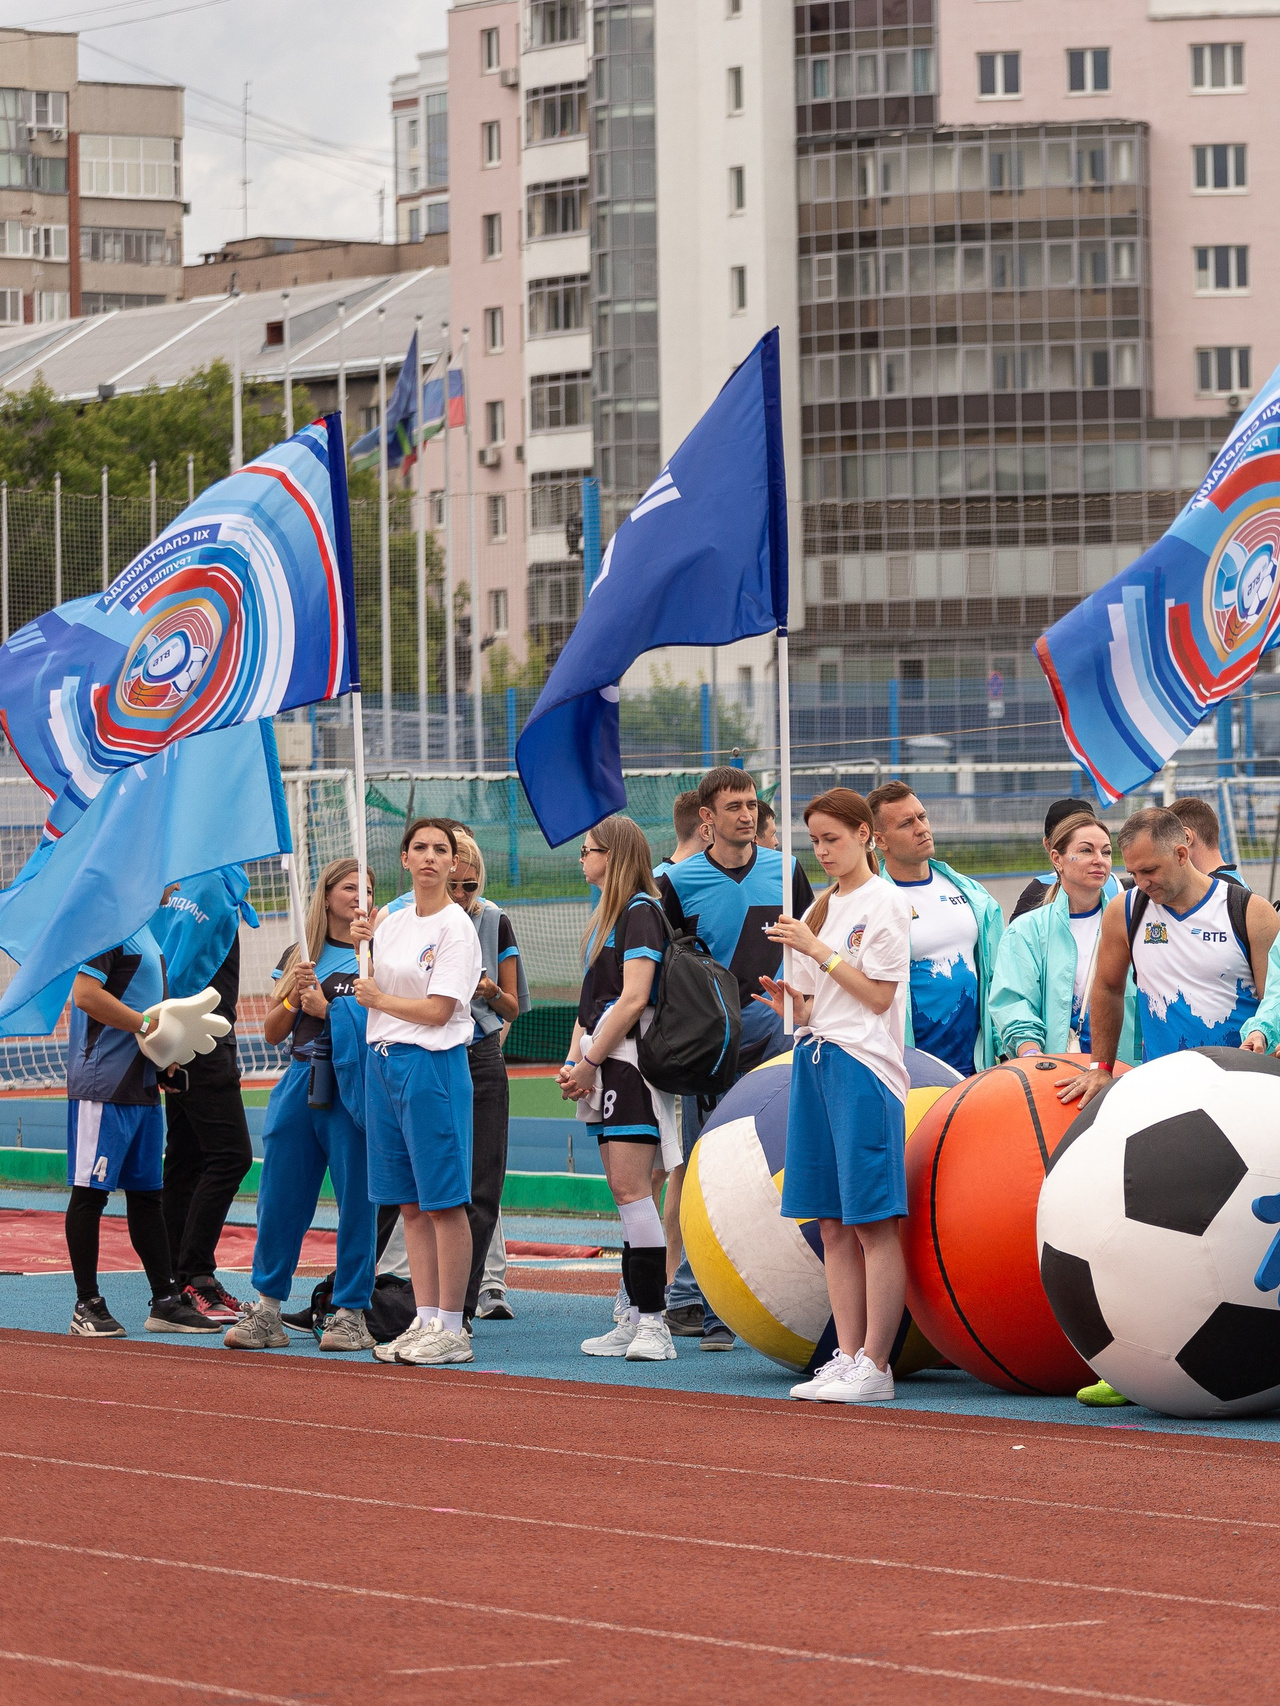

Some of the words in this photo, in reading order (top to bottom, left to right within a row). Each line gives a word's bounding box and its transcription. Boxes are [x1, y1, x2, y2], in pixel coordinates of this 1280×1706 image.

[1202, 931, 1228, 943] ВТБ
[603, 1089, 617, 1119] 8
[92, 1155, 108, 1183] 4
